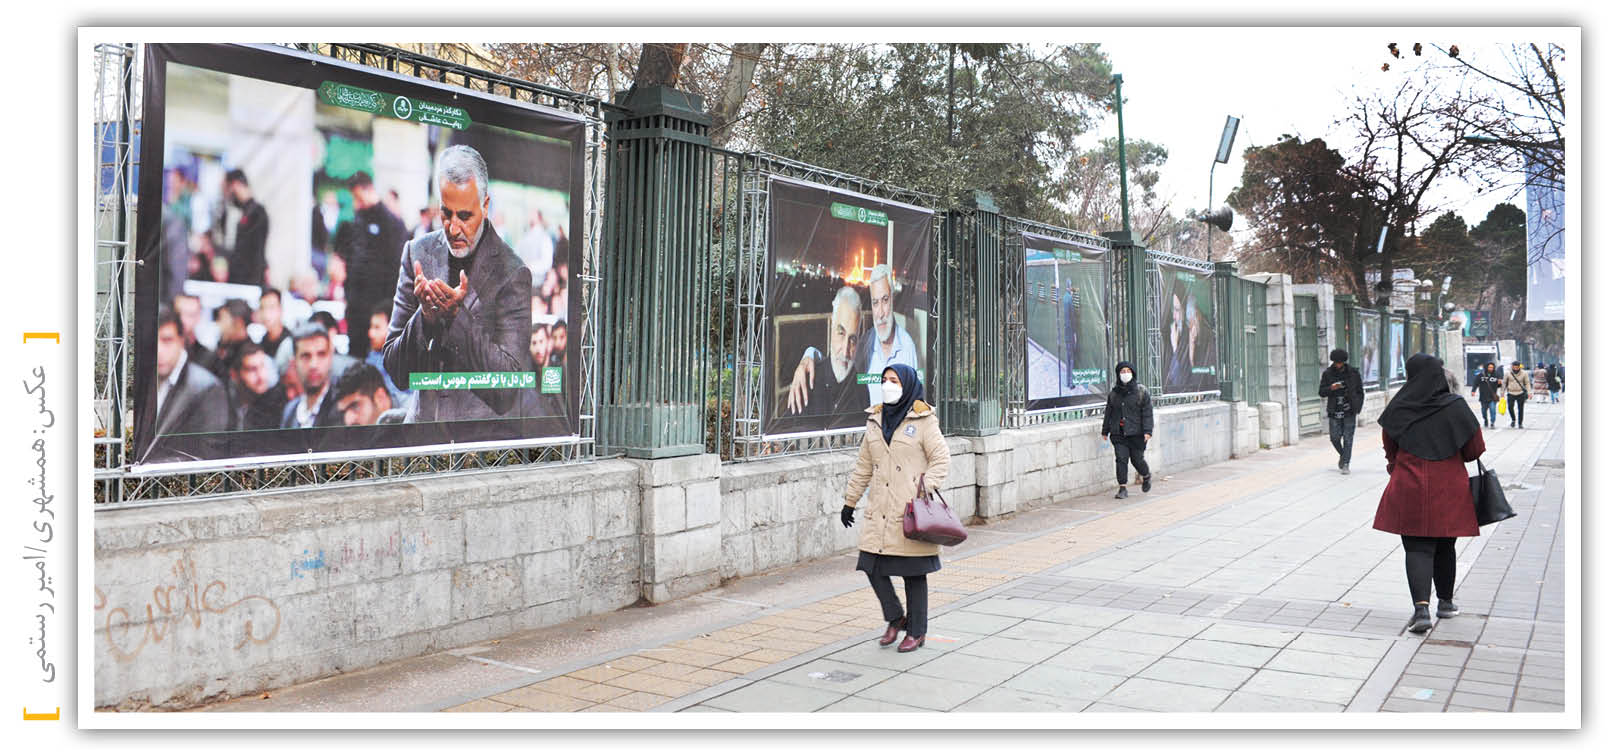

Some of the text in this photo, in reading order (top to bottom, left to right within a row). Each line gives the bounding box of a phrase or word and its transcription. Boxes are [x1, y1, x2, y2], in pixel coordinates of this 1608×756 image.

[443, 374, 467, 389] هوس
[491, 374, 500, 388] تو
[500, 374, 507, 387] با
[508, 374, 518, 387] دل
[521, 374, 533, 387] حال
